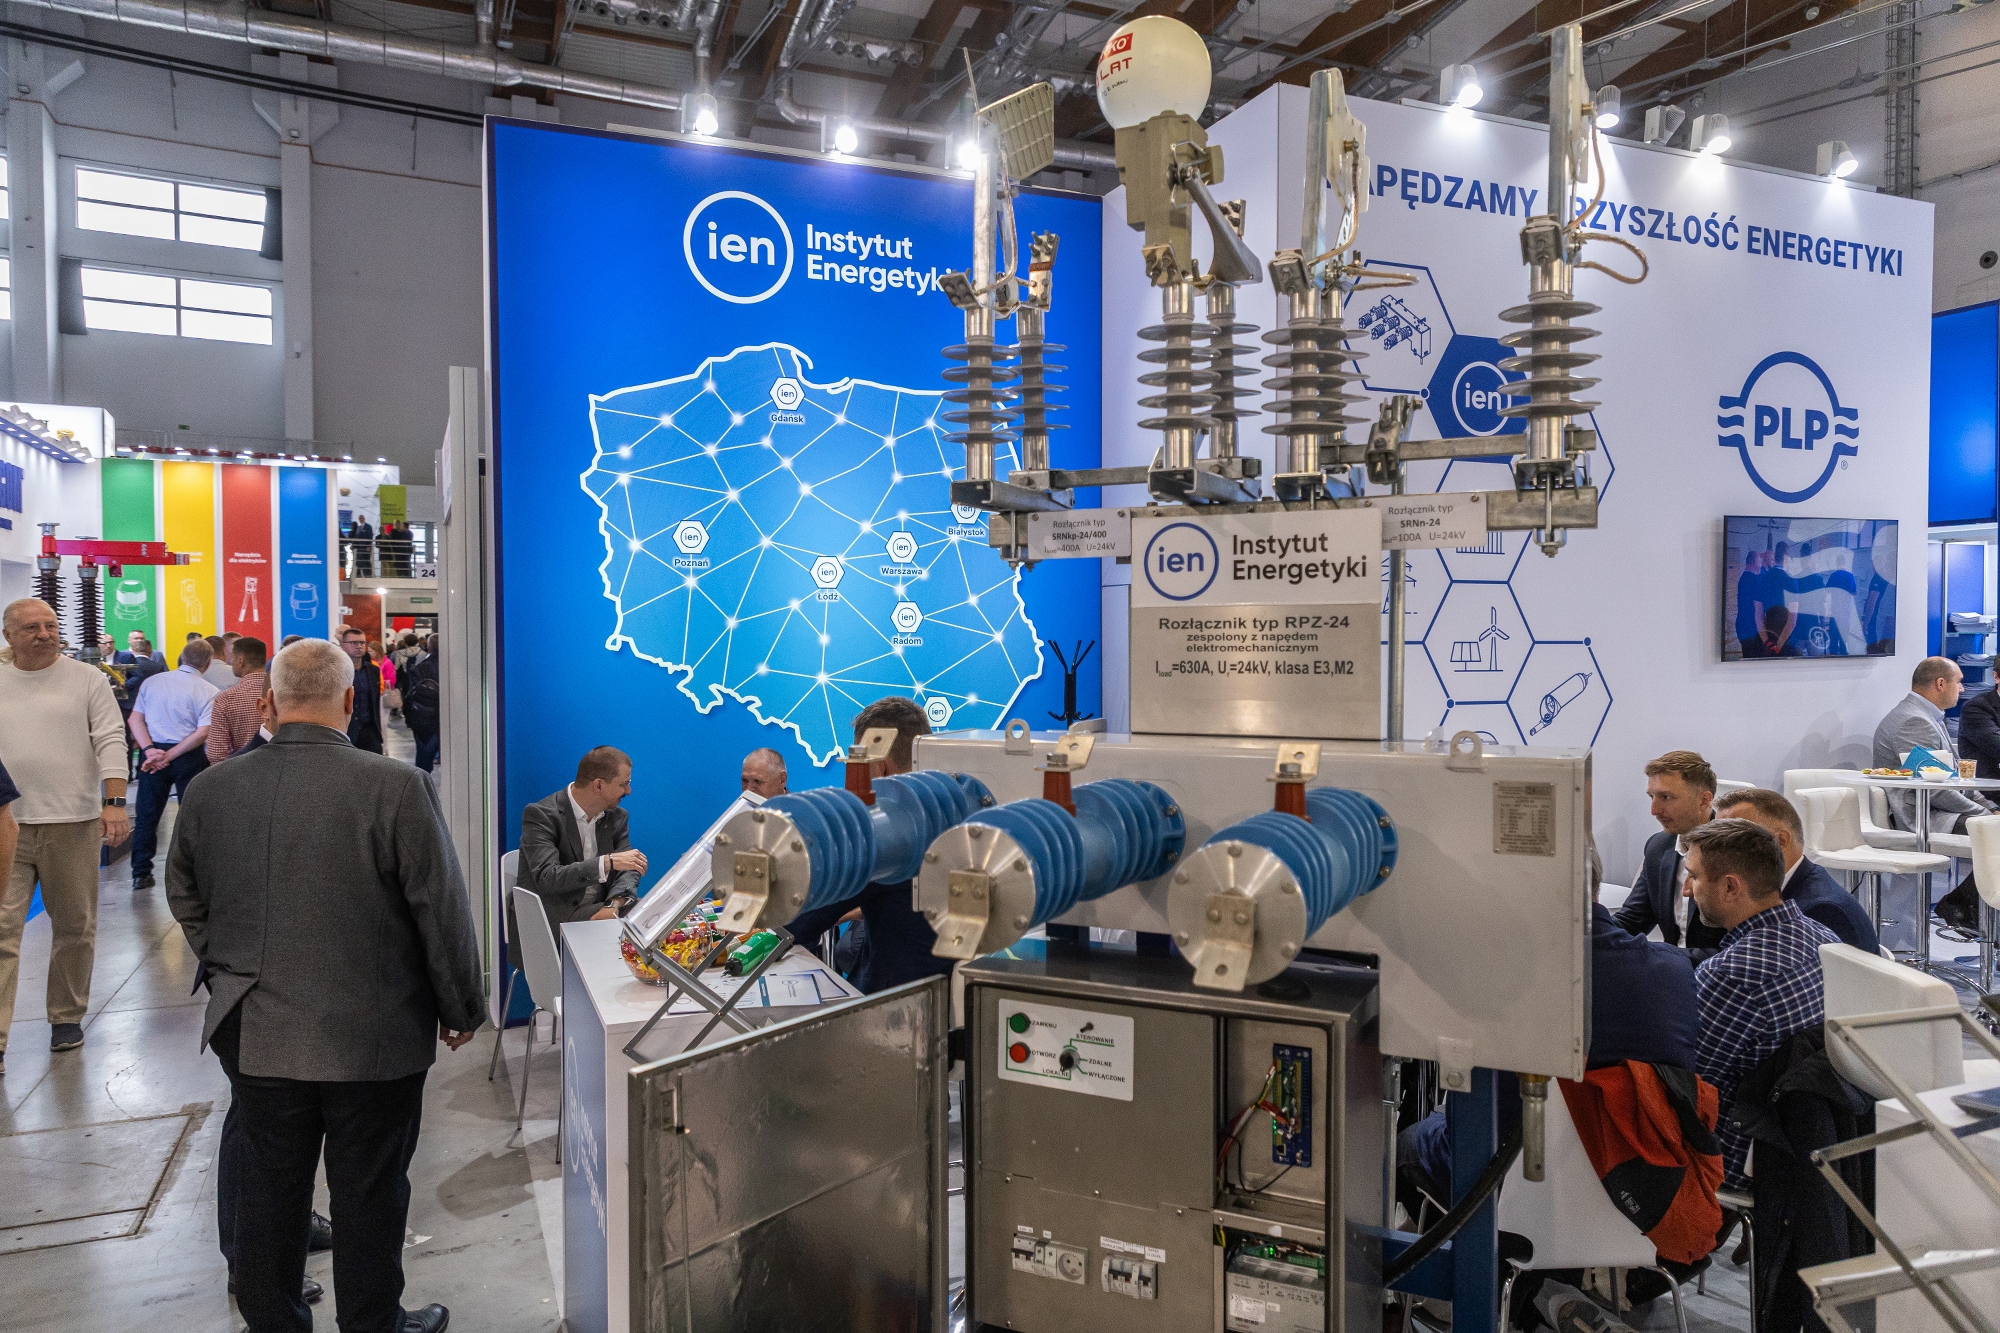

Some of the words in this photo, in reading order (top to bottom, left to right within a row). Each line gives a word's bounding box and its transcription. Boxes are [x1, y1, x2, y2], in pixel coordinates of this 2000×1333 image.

[1100, 57, 1132, 80] LAT
[1368, 164, 1538, 218] PĘDZAMY
[1569, 195, 1739, 251] RZYSZŁOŚĆ
[1747, 225, 1903, 277] ENERGETYKI
[708, 221, 775, 266] ien
[806, 223, 912, 261] Instytut
[806, 254, 951, 296] Energetyk
[781, 389, 795, 398] ien
[1465, 382, 1502, 411] ien
[771, 414, 804, 423] Gdańsk
[1754, 404, 1829, 450] PLP
[1388, 505, 1436, 515] Rozłącznik
[1438, 504, 1454, 515] typ
[1053, 519, 1092, 529] Rozłącznik
[1093, 519, 1106, 528] typ
[1400, 518, 1441, 528] SRNn-24
[685, 532, 699, 541] ien
[948, 528, 985, 537] Białystok
[1052, 530, 1107, 541] SRNkp-24/400
[1429, 531, 1466, 541] U=24kV
[896, 543, 909, 551] ien
[1086, 542, 1116, 552] U=24kV
[1232, 533, 1329, 559] Instytut
[674, 558, 709, 567] Poznań
[1159, 546, 1204, 573] ien
[421, 569, 436, 578] 24
[821, 568, 835, 576] ien
[881, 567, 923, 575] Warszawa
[1232, 555, 1367, 585] Energetyki
[818, 592, 839, 601] Łódź
[901, 613, 914, 621] ien
[1159, 616, 1248, 633] Rozłącznik
[1252, 618, 1279, 632] typ
[1285, 616, 1350, 629] RPZ-24
[893, 637, 922, 645] Radom
[1186, 632, 1247, 644] zespolony
[1251, 633, 1258, 641] z
[1261, 632, 1318, 644] napędem
[1186, 643, 1319, 655] elektromechanicznym
[1275, 660, 1310, 675] klasa
[1314, 660, 1354, 677] E3,M2
[931, 707, 944, 716] ien
[1076, 1034, 1115, 1044] STEROWANIE
[1032, 1050, 1056, 1059] OTWÓRZ
[1089, 1058, 1112, 1067] ZDALNE
[1089, 1071, 1126, 1083] WYŁĄCZONE
